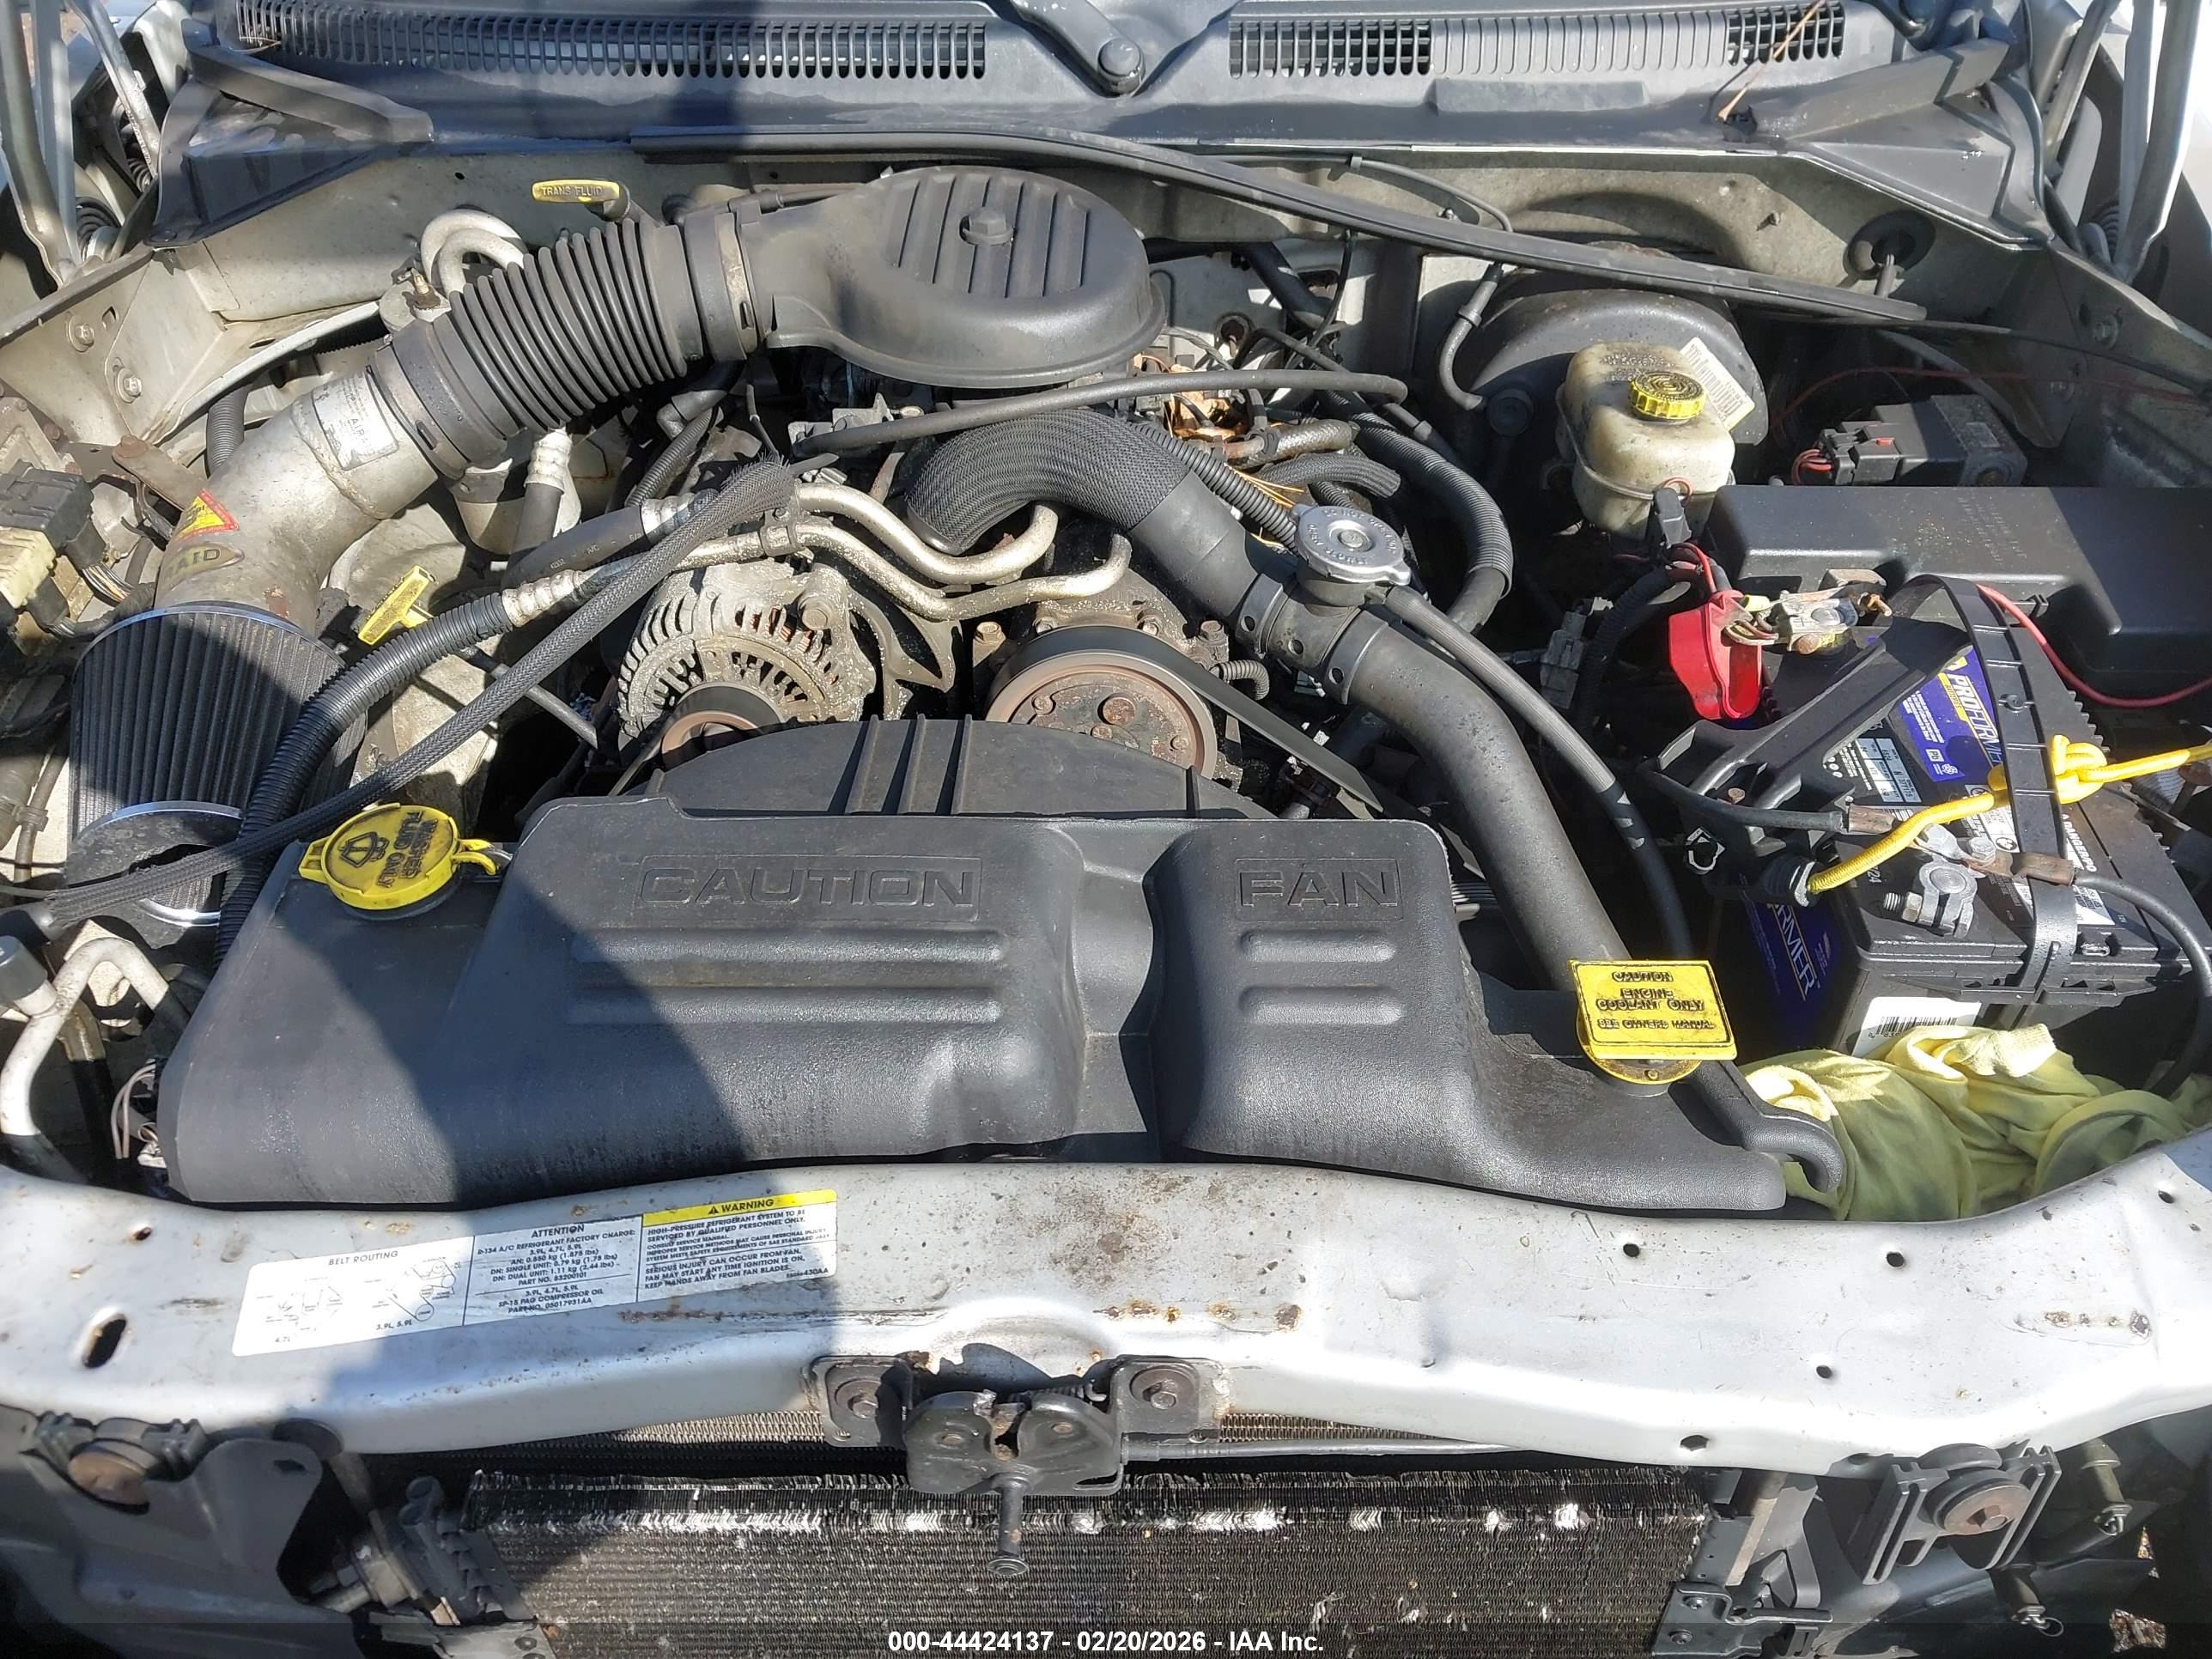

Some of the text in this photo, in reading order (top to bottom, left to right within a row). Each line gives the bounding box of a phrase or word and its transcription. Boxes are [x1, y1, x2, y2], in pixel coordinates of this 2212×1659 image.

[542, 185, 604, 197] TRANS FLUID
[376, 811, 427, 889] FLUID ONLY
[398, 818, 439, 879] WASHER
[641, 867, 974, 907] CAUTION
[1239, 871, 1398, 907] FAN
[1612, 971, 1674, 983] CAUTION
[1620, 988, 1674, 1000] ENGINE
[1596, 999, 1705, 1012] COOLANT ONLY
[721, 1199, 775, 1212] WARNING
[531, 1224, 585, 1238] ATTENTION
[647, 1222, 704, 1235] HIGH-PRESSURE
[706, 1215, 755, 1228] REFRIGERANT
[757, 1212, 783, 1220] SYSTEM
[647, 1232, 684, 1243] SERVICED
[697, 1225, 737, 1237] QUALIFIED
[738, 1220, 782, 1230] PERSONNEL
[516, 1238, 565, 1250] REFRIGERANT
[567, 1234, 600, 1243] FACTORY
[602, 1230, 636, 1239] CHARGE:
[647, 1247, 678, 1255] IMPROPER
[678, 1243, 704, 1252] SERVICE
[705, 1239, 734, 1248] METHODS
[772, 1231, 804, 1239] PERSONAL
[647, 1241, 675, 1249] CONSULT
[328, 1250, 398, 1266] BELT ROUTING
[645, 1264, 678, 1274] SERIOUS
[678, 1259, 707, 1269] INJURY
[728, 1253, 758, 1262] OCCUR
[760, 1250, 782, 1259] FROM
[646, 1254, 668, 1262] SYSTEM
[505, 1264, 532, 1273] SINGLE
[681, 1268, 704, 1277] START
[744, 1258, 780, 1268] IGNITION
[507, 1272, 527, 1280] DUAL
[665, 1277, 692, 1286] HANDS
[694, 1273, 716, 1283] AWAY
[719, 1270, 741, 1279] FROM
[538, 1290, 590, 1303] COMPRESSOR
[507, 1305, 527, 1314] PART
